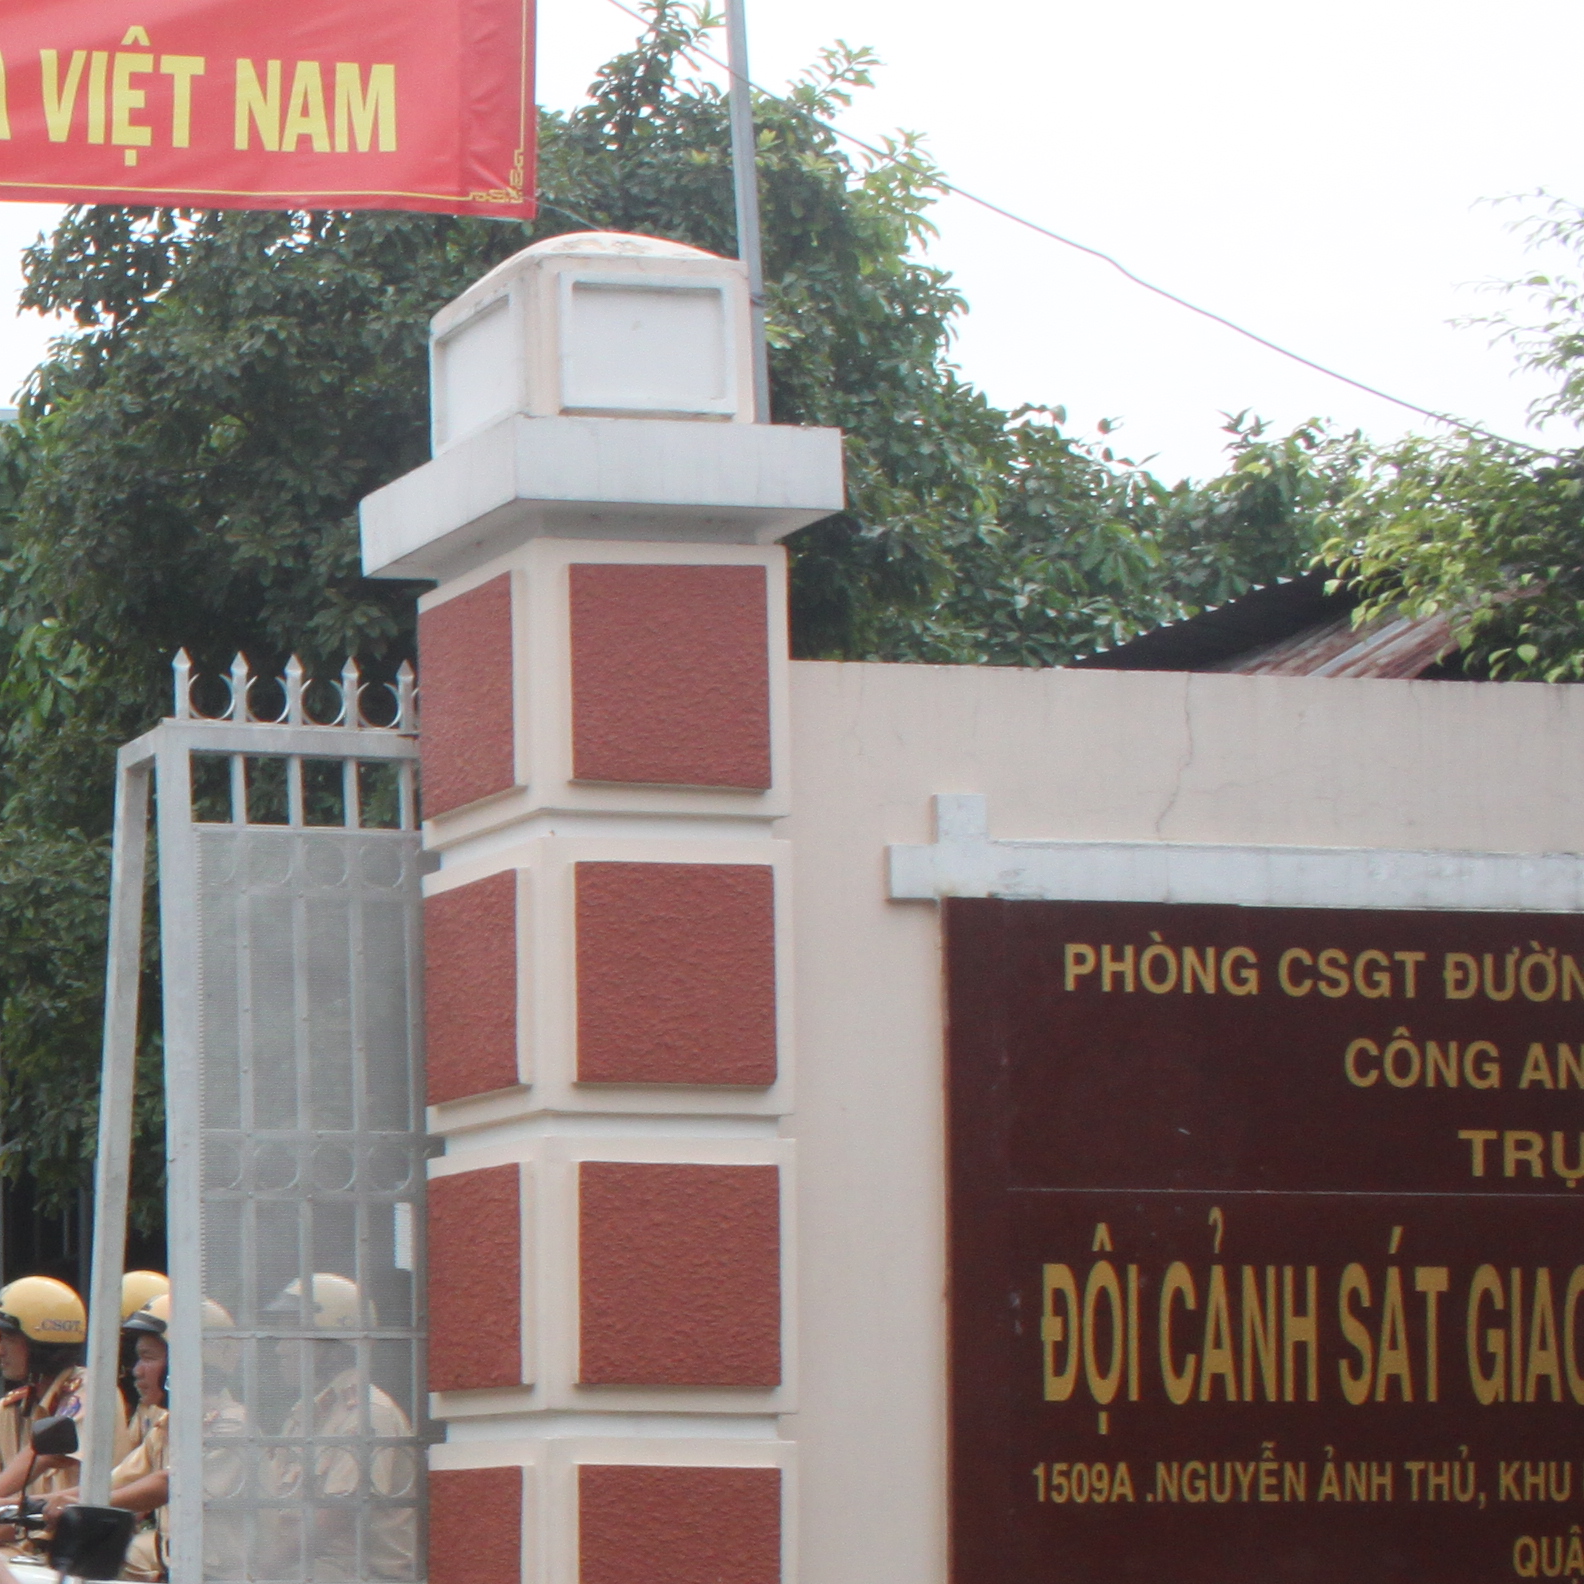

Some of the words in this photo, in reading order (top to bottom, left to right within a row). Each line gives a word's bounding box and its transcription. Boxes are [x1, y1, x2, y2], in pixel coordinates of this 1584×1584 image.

[39, 25, 206, 166] VIỆT
[233, 58, 397, 153] NAM
[1063, 932, 1260, 996] PHÒNG
[1277, 947, 1426, 999] CSGT
[1344, 1026, 1501, 1090] CÔNG
[1518, 1041, 1584, 1090] AN
[1040, 1222, 1141, 1435] ĐỘI
[1158, 1207, 1318, 1405] CẢNH
[1338, 1226, 1450, 1405] SÁT
[1032, 1461, 1134, 1503] 1509A
[1317, 1445, 1393, 1503] ẢNH
[1404, 1445, 1487, 1509] THỦ,
[1499, 1461, 1573, 1502] KHU
